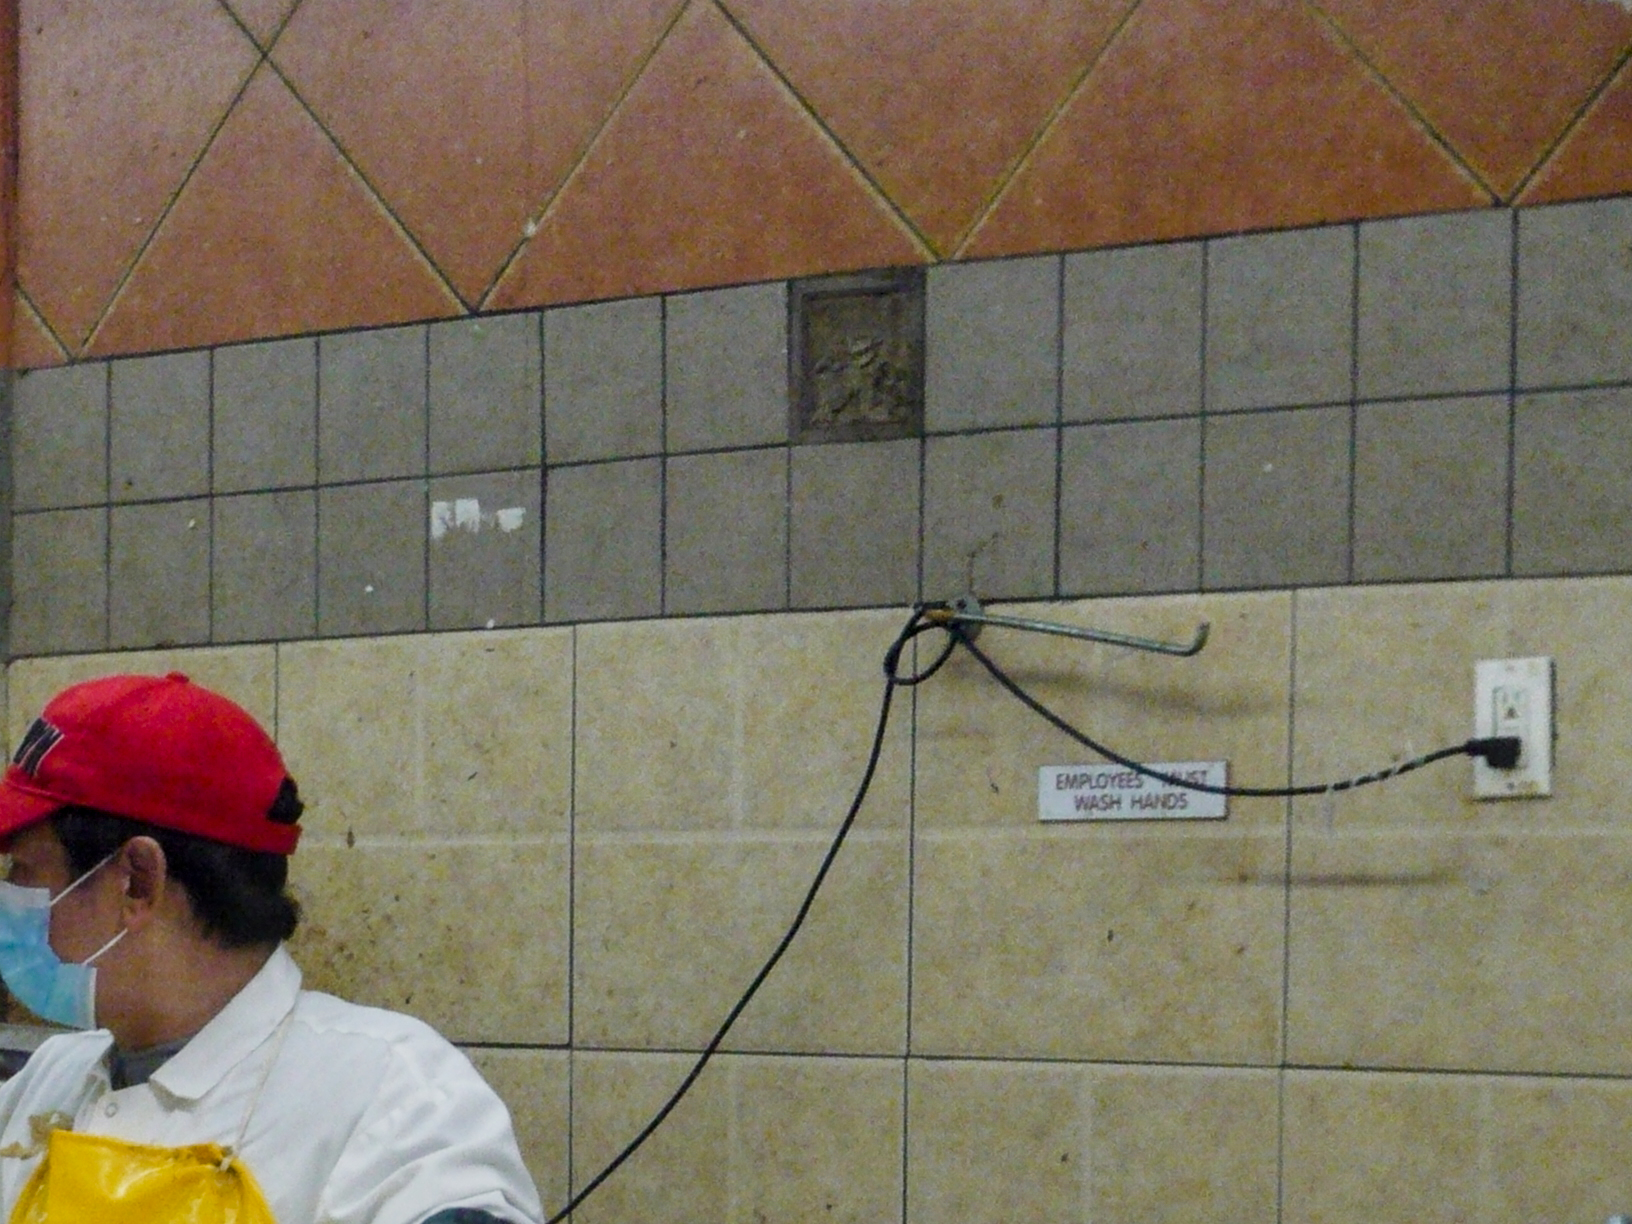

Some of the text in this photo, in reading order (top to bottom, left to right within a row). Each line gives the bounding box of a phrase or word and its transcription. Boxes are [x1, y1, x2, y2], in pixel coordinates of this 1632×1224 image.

[1055, 771, 1144, 791] EMPLOYEES
[1074, 793, 1190, 812] WASH HANDS
